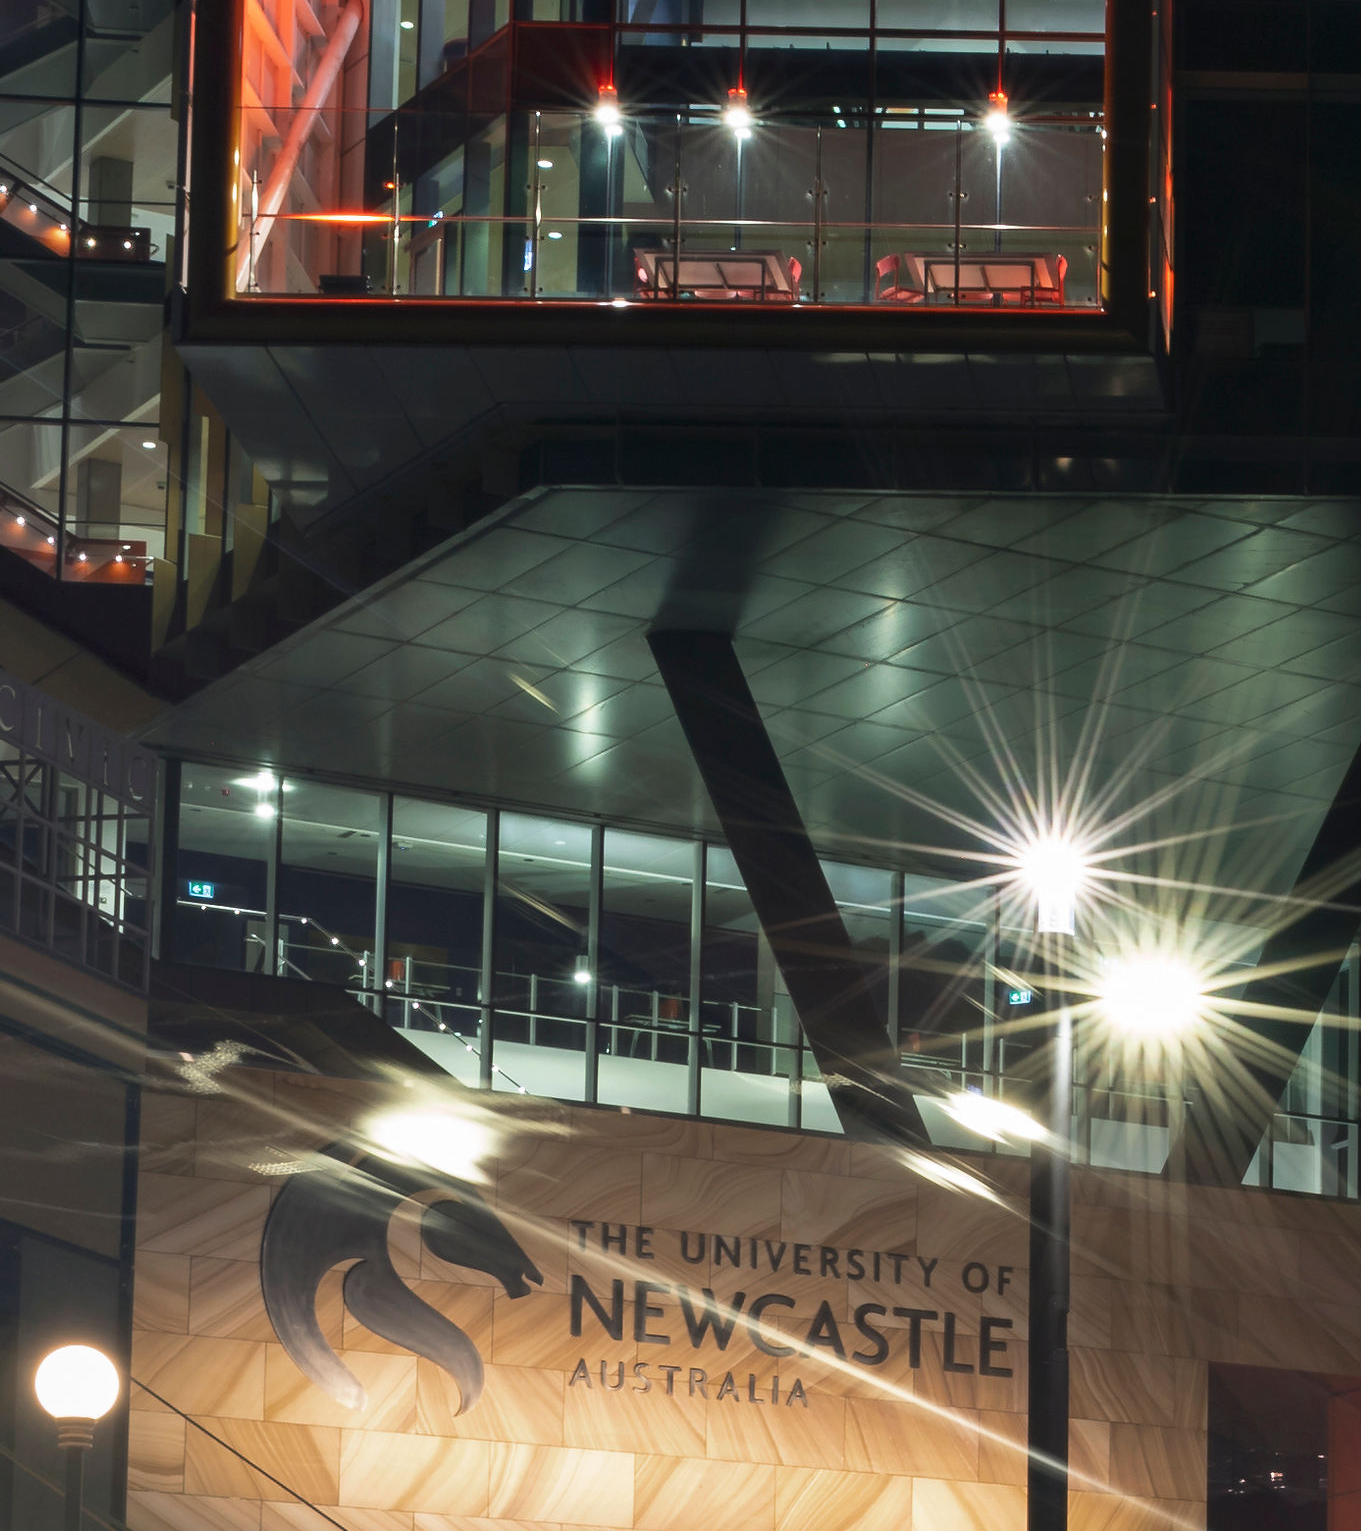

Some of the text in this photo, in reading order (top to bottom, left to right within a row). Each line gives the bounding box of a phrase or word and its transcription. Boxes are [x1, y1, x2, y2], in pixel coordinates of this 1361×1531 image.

[570, 1220, 1015, 1297] THE UNIVERSITY OF
[570, 1274, 1014, 1378] NEWCASTLE
[569, 1357, 810, 1408] AUSTRALIA
